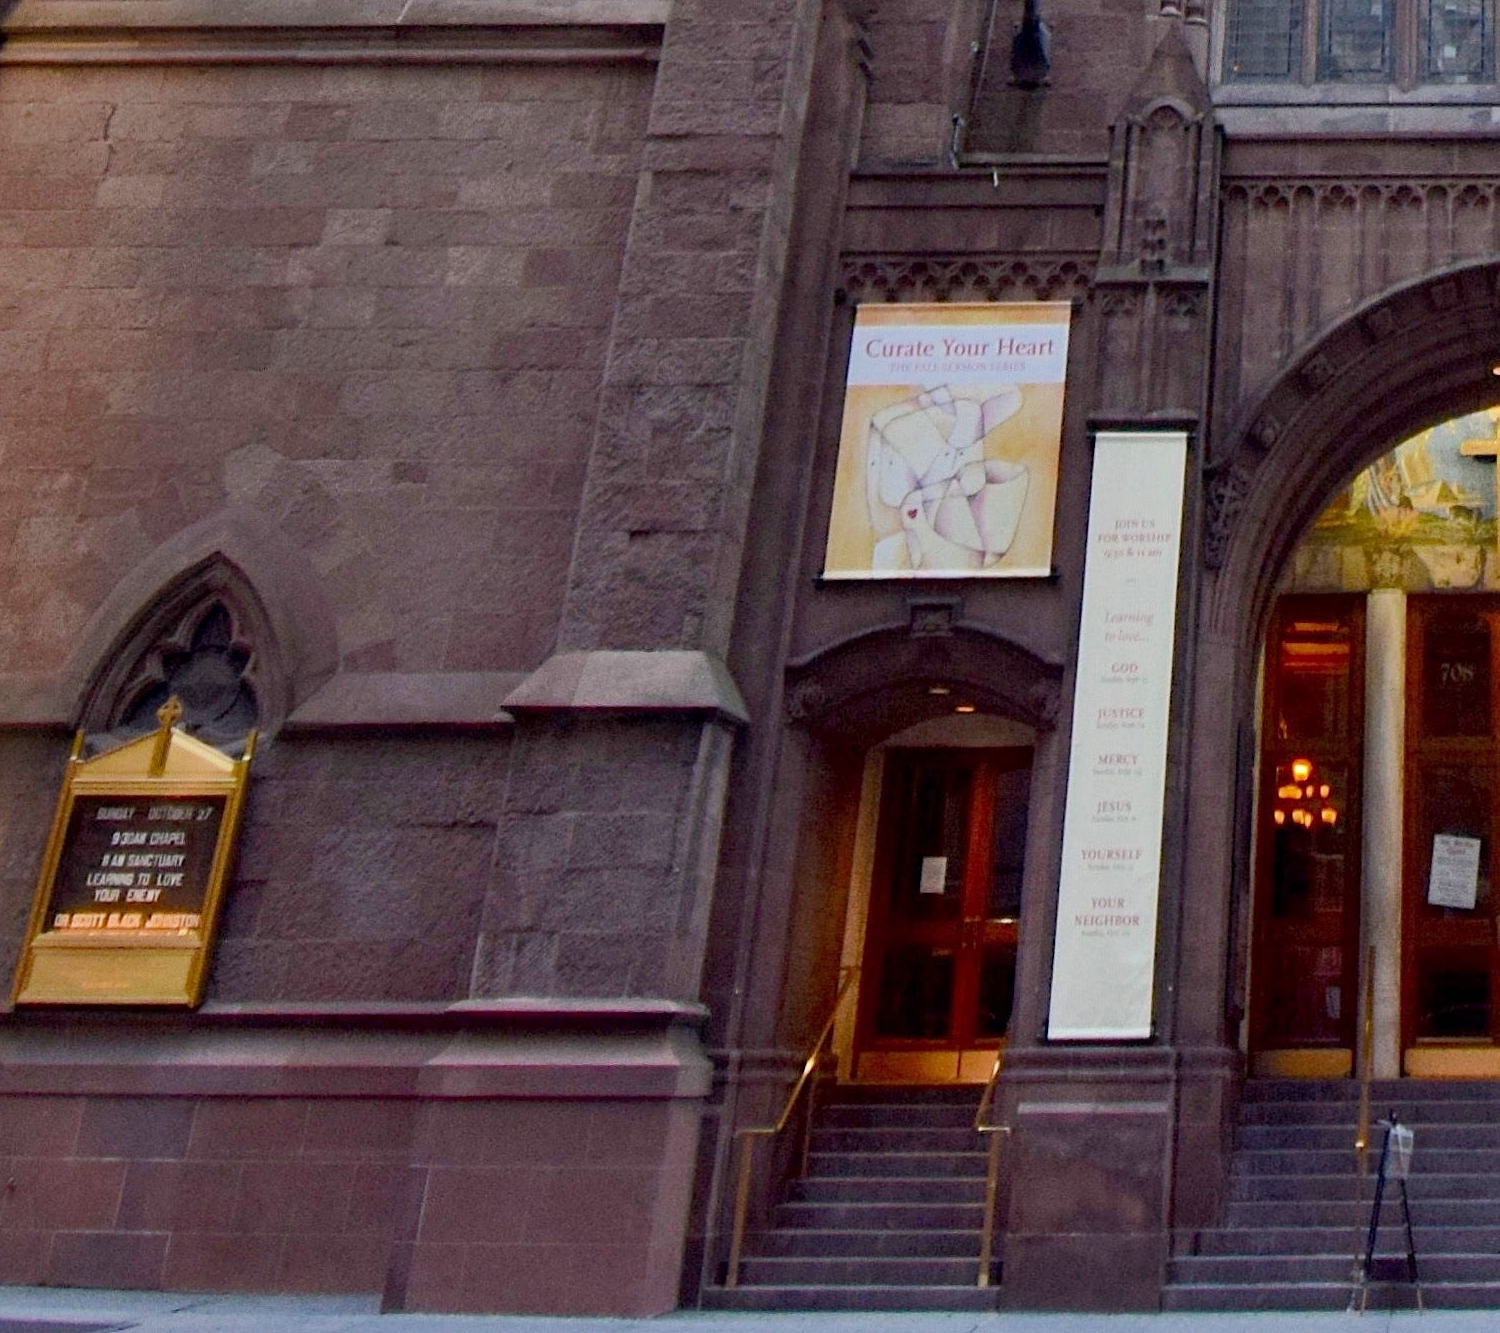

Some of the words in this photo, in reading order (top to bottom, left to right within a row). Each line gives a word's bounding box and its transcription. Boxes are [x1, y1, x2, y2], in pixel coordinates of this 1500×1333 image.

[865, 338, 935, 359] Curate
[943, 338, 990, 357] Your
[997, 337, 1056, 357] Heart
[1121, 533, 1172, 543] WORSHIP
[1104, 611, 1154, 626] Learning
[1111, 662, 1139, 674] GOD
[1440, 661, 1474, 684] 708
[1097, 708, 1145, 721] JUSTICE
[1097, 753, 1140, 765] MERCY
[148, 807, 193, 820] OCTOBER
[1096, 800, 1132, 814] JESUS
[150, 832, 186, 845] CHAPEL
[128, 854, 185, 867] SANCTUARY
[1081, 848, 1142, 861] YOURSELF
[87, 873, 133, 885] LEARNING
[138, 874, 151, 886] TO
[157, 874, 184, 886] LOVE
[94, 889, 120, 901] YOUR
[127, 889, 161, 902] ENEMY
[1091, 897, 1125, 909] YOUR
[71, 914, 107, 928] SCOTT
[108, 914, 142, 928] BLACK
[146, 914, 200, 928] JOHNSTON
[1074, 915, 1141, 927] NEIGHBOR
